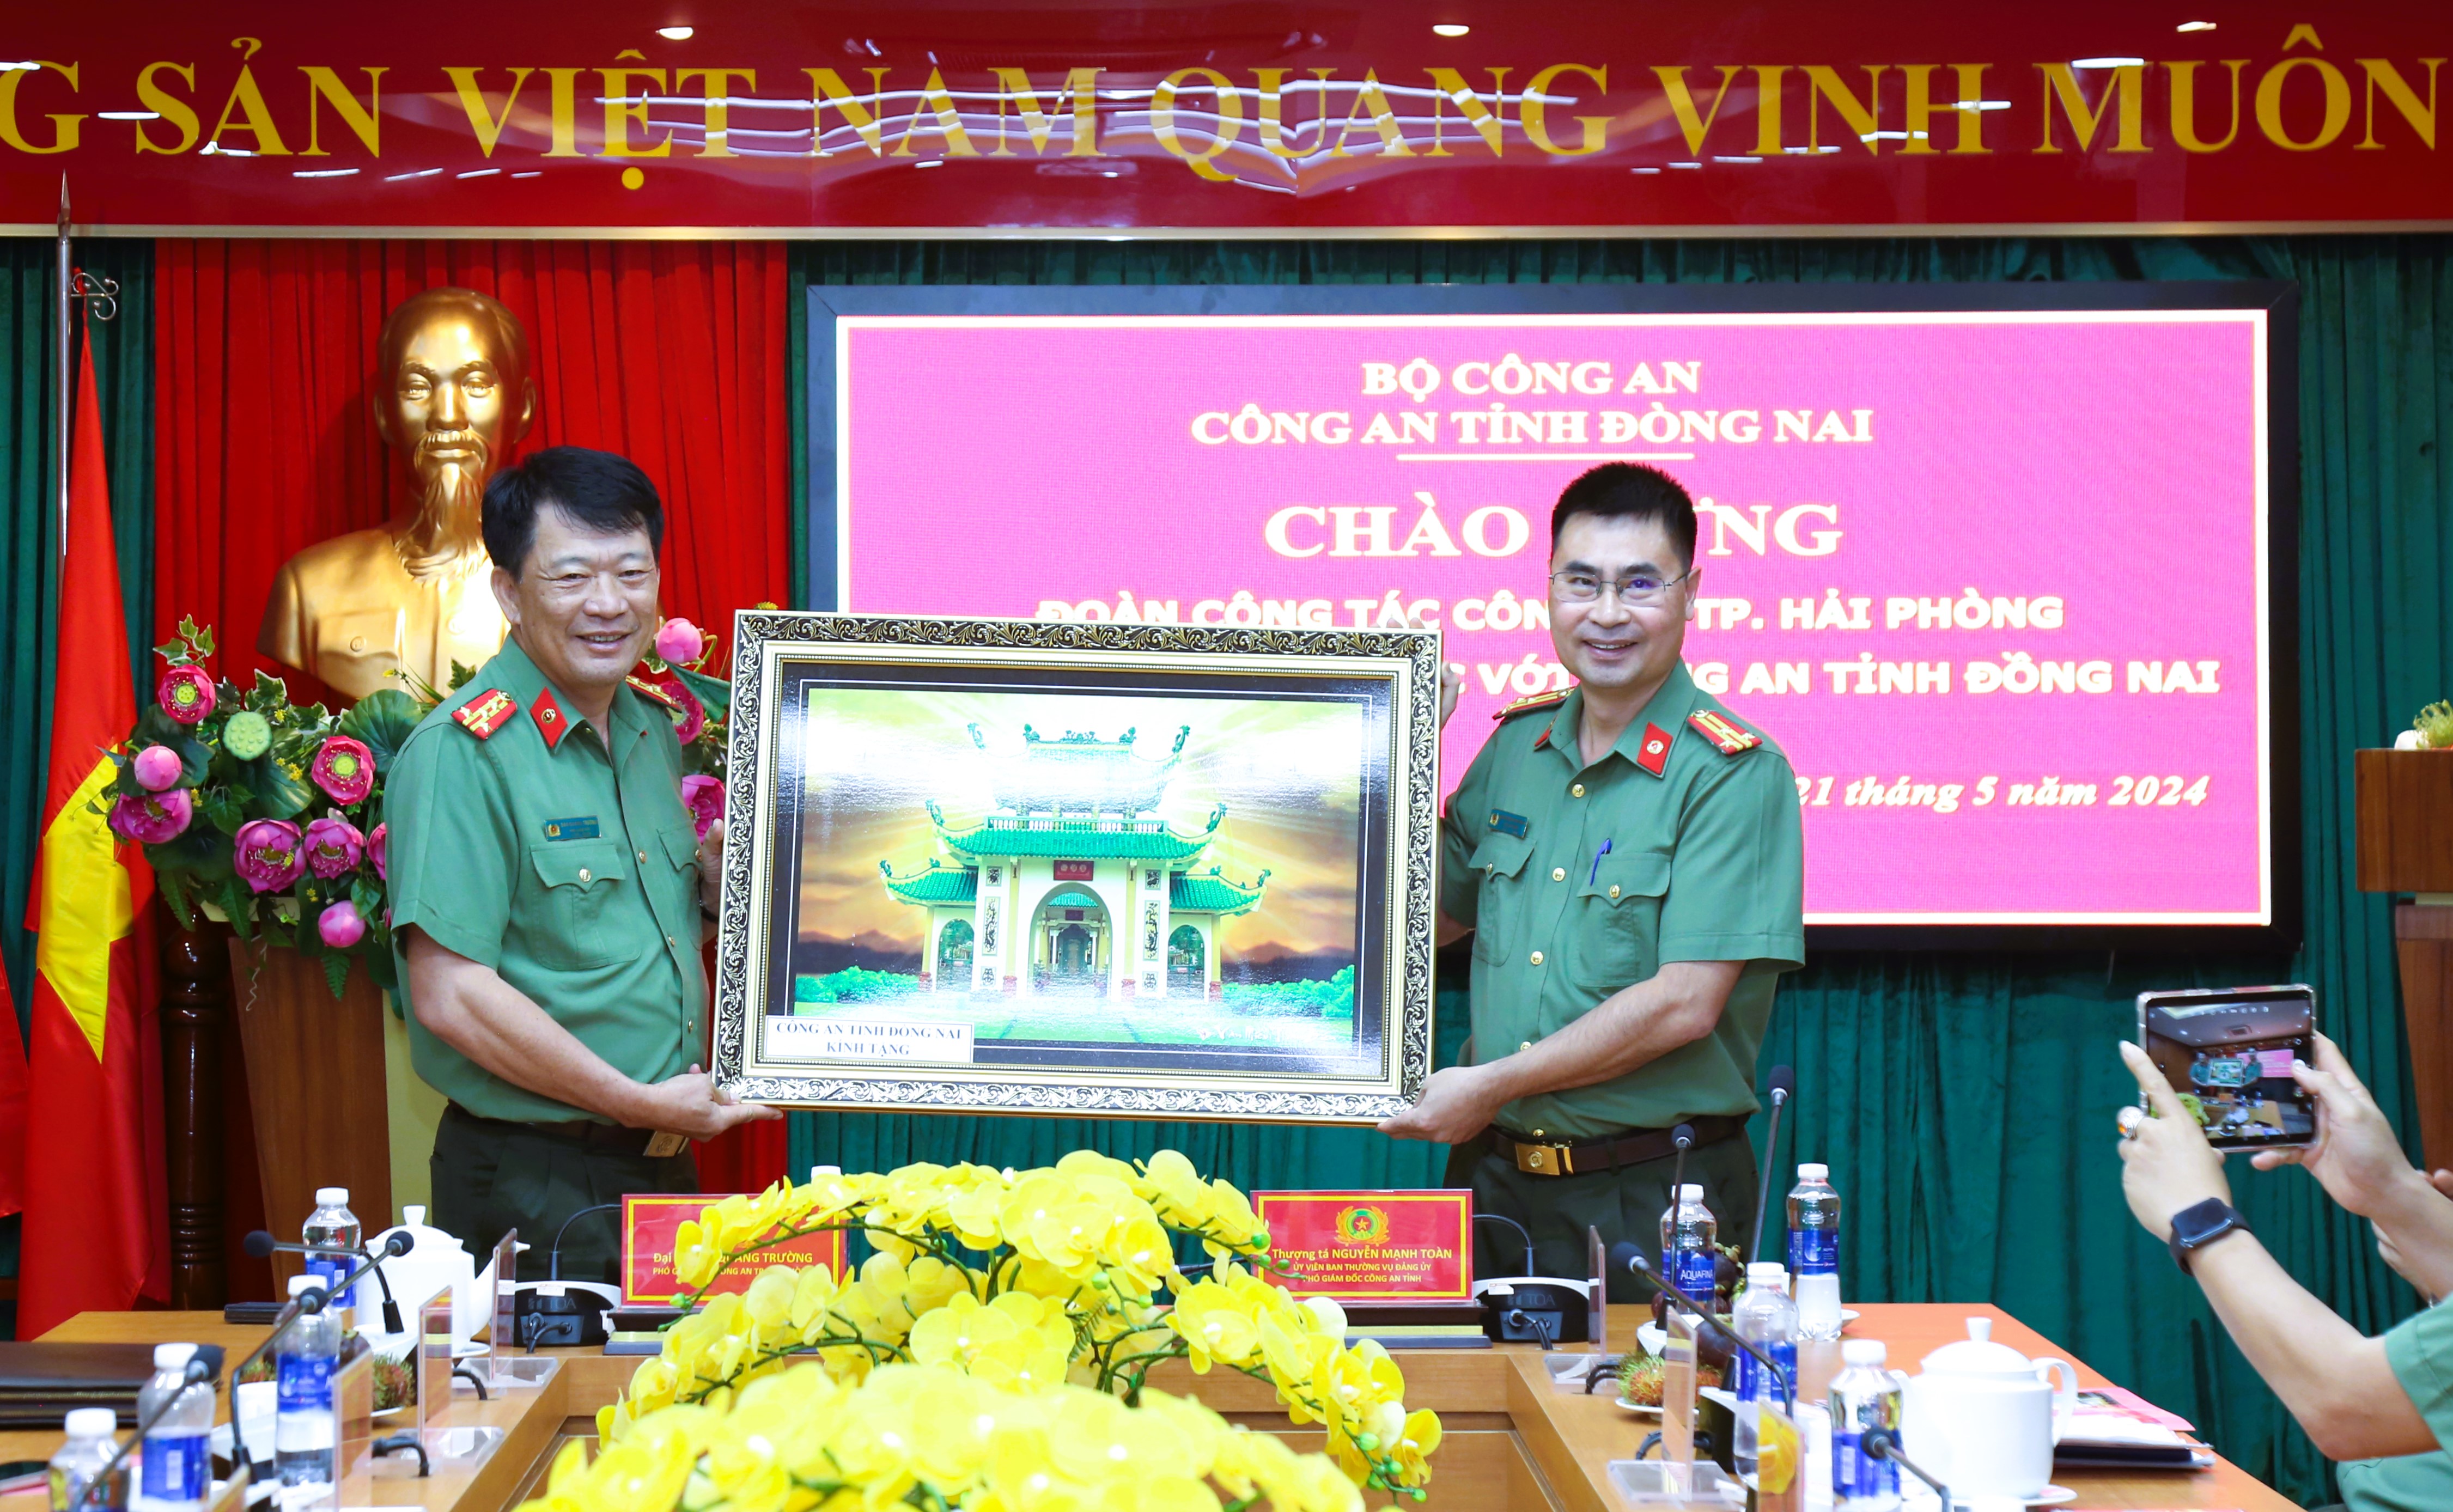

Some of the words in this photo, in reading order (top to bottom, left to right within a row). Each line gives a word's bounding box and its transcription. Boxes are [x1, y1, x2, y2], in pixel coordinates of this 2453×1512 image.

[136, 38, 389, 157] SẢN
[441, 49, 756, 190] VIỆT
[801, 67, 1106, 157] NAM
[1150, 64, 1616, 181] QUANG
[1650, 64, 1994, 156] VINH
[2032, 25, 2448, 151] MUÔN
[1362, 358, 1440, 402] BỘ
[1452, 353, 1611, 394] CÔNG
[1623, 362, 1701, 394] AN
[1191, 404, 1352, 444] CÔNG
[1361, 412, 1439, 443] AN
[1451, 403, 1588, 443] TỈNH
[1774, 410, 1873, 442] NAI
[1265, 491, 1529, 558] CHÀO
[1693, 497, 1843, 556] NG
[1036, 590, 1178, 621] ĐOÀN
[1192, 590, 1332, 624] CÔNG
[1344, 590, 1440, 628] TÁC
[1453, 589, 1551, 630] CÔN
[1694, 598, 1764, 630] TP.
[1781, 588, 1871, 629] HẢI
[1886, 587, 2063, 629] PHÒNG
[1740, 662, 1809, 694] AN
[1823, 652, 1950, 693] TỈNH
[1964, 651, 2112, 693] ĐỒNG
[2128, 661, 2220, 693] NAI
[1845, 776, 1964, 813] tháng
[1973, 776, 1998, 806] 5
[2007, 777, 2096, 806] năm
[2108, 776, 2209, 806] 2024
[777, 1020, 819, 1034] CÔNG
[824, 1024, 843, 1034] AN
[935, 1028, 960, 1039] NAI
[827, 1039, 863, 1053] KÍNH
[653, 1252, 672, 1265] Đại
[763, 1251, 813, 1263] TRƯỜNG
[1272, 1248, 1316, 1261] Thượng
[1318, 1248, 1329, 1259] tá
[1332, 1245, 1379, 1259] NGUYỄN
[1382, 1249, 1417, 1261] MẠNH
[1421, 1246, 1452, 1259] TOÀN
[653, 1266, 670, 1275] PHÓ
[1306, 1262, 1324, 1271] VIÊN
[1344, 1262, 1380, 1271] THƯỜNG
[1381, 1264, 1393, 1272] VỤ
[1395, 1261, 1419, 1271] ĐẢNG
[1322, 1273, 1344, 1282] GIÁM
[1345, 1272, 1363, 1282] ĐỐC
[1364, 1273, 1387, 1282] CÔNG
[1526, 1294, 1555, 1306] TOA
